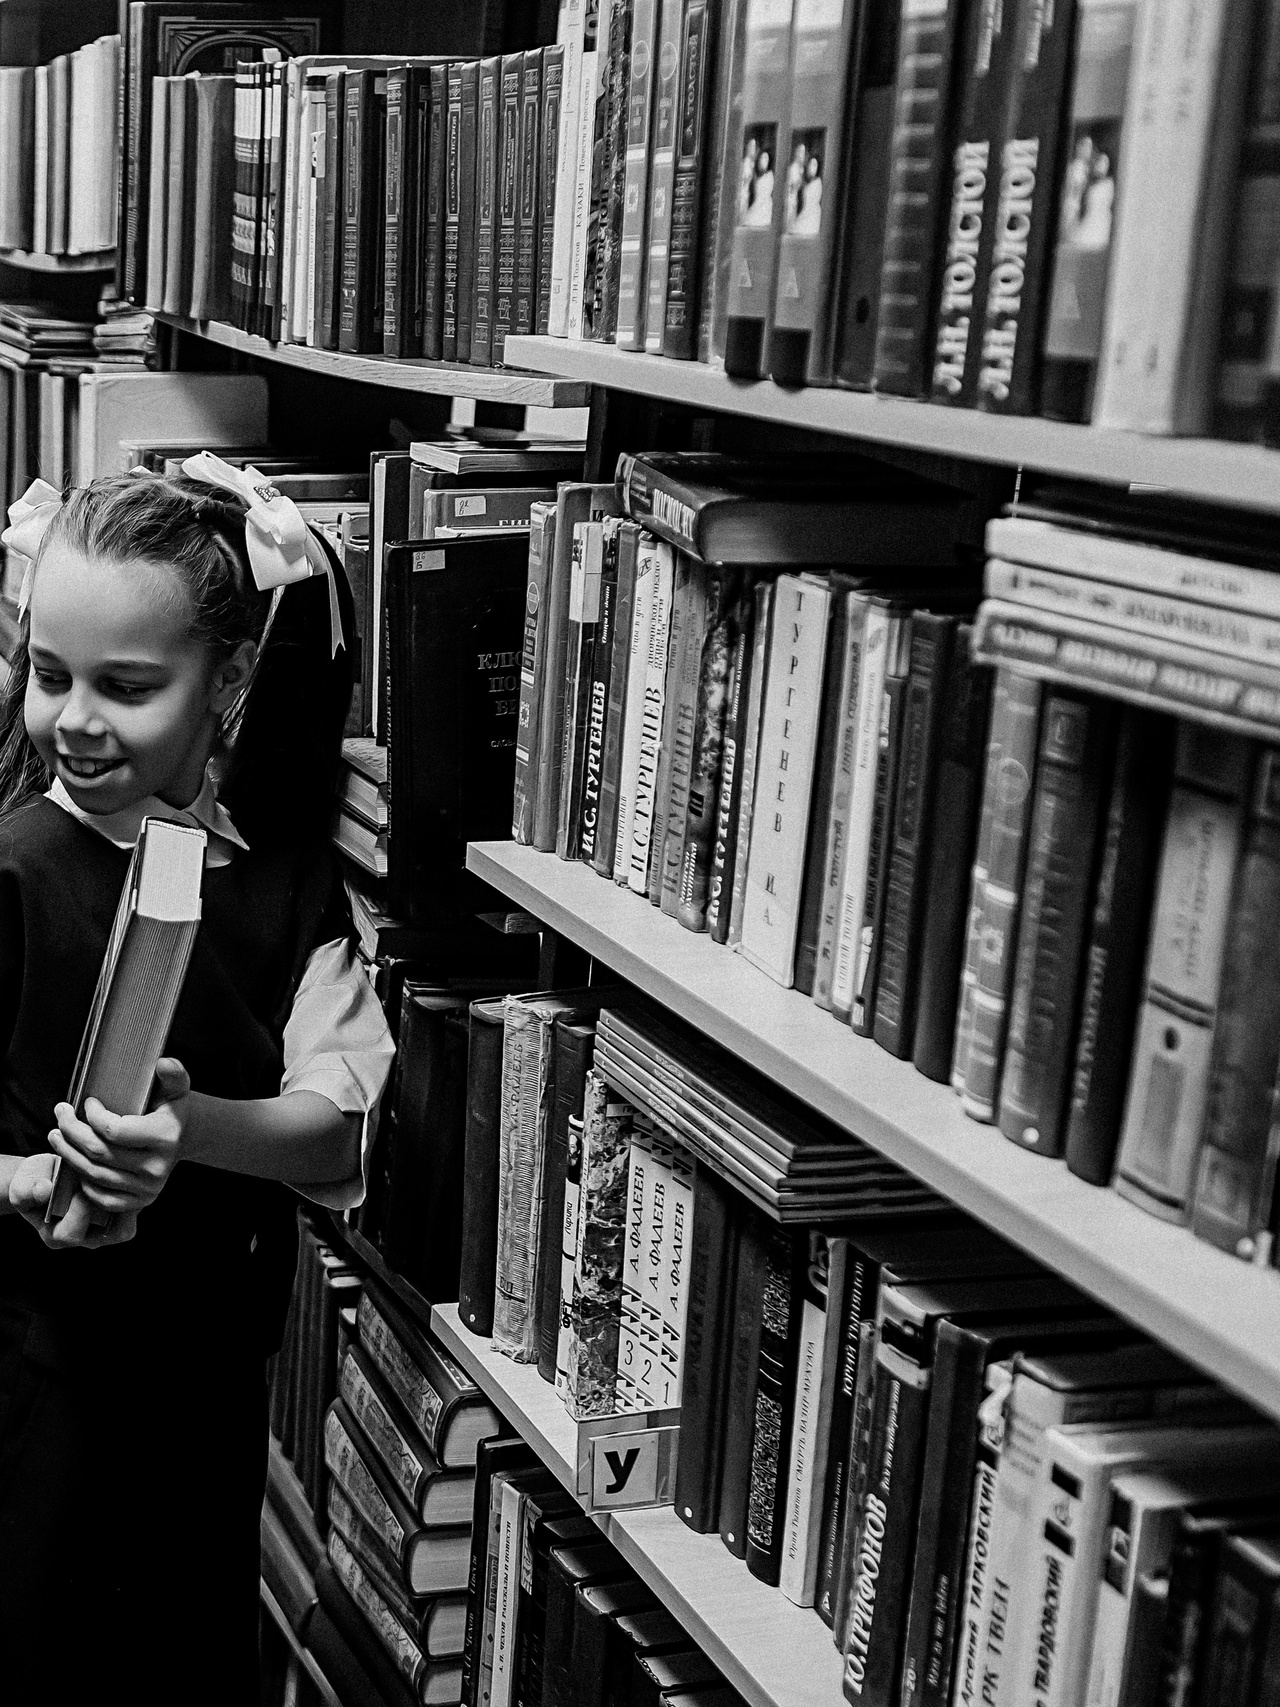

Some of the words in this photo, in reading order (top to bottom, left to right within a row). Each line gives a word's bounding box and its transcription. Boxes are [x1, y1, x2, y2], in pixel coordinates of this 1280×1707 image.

[575, 182, 585, 228] КАЗАКИ
[940, 140, 990, 315] ТОЛСТОЙ
[986, 138, 1040, 318] ТОЛСТОЙ
[773, 590, 805, 833] ТУРГЕНЕВ
[584, 682, 605, 801] ТУРГЕНЕВ
[635, 686, 661, 823] ТУРГЕНЕВ
[666, 702, 695, 835] ТУРГЕНЕВ
[510, 1042, 524, 1107] ФАДЕЕВ
[564, 1202, 574, 1236] Лирика
[628, 1165, 645, 1250] ФАДЕЕВ
[649, 1182, 666, 1267] ФАДЕЕВ
[631, 1255, 641, 1275] А.
[670, 1202, 685, 1287] ФАДЕЕВ
[649, 1271, 658, 1293] А.
[670, 1292, 680, 1312] А.
[847, 1261, 865, 1343] ТЫНЯНОВ
[624, 1339, 634, 1366] 3
[641, 1359, 652, 1386] 2
[801, 1339, 816, 1395] МУХТАРА
[841, 1345, 857, 1398] ЮРИЙ
[663, 1381, 670, 1405] 1
[798, 1396, 811, 1434] ВАЗИР
[794, 1437, 808, 1483] СМЕРТЬ
[791, 1486, 803, 1530] Тынянов
[504, 1520, 512, 1562] ПОВЕСТИ
[788, 1531, 800, 1561] Юрий
[970, 1470, 995, 1609] ТАРКОВСКИЙ
[501, 1572, 510, 1620] РАССКАЗЫ
[985, 1577, 1011, 1656] ТВЕН
[464, 1611, 475, 1648] Чехов
[499, 1620, 507, 1652] ЧЕХОВ
[1034, 1555, 1062, 1695] ТВАРДОВСКИЙ
[961, 1621, 980, 1707] Арсений
